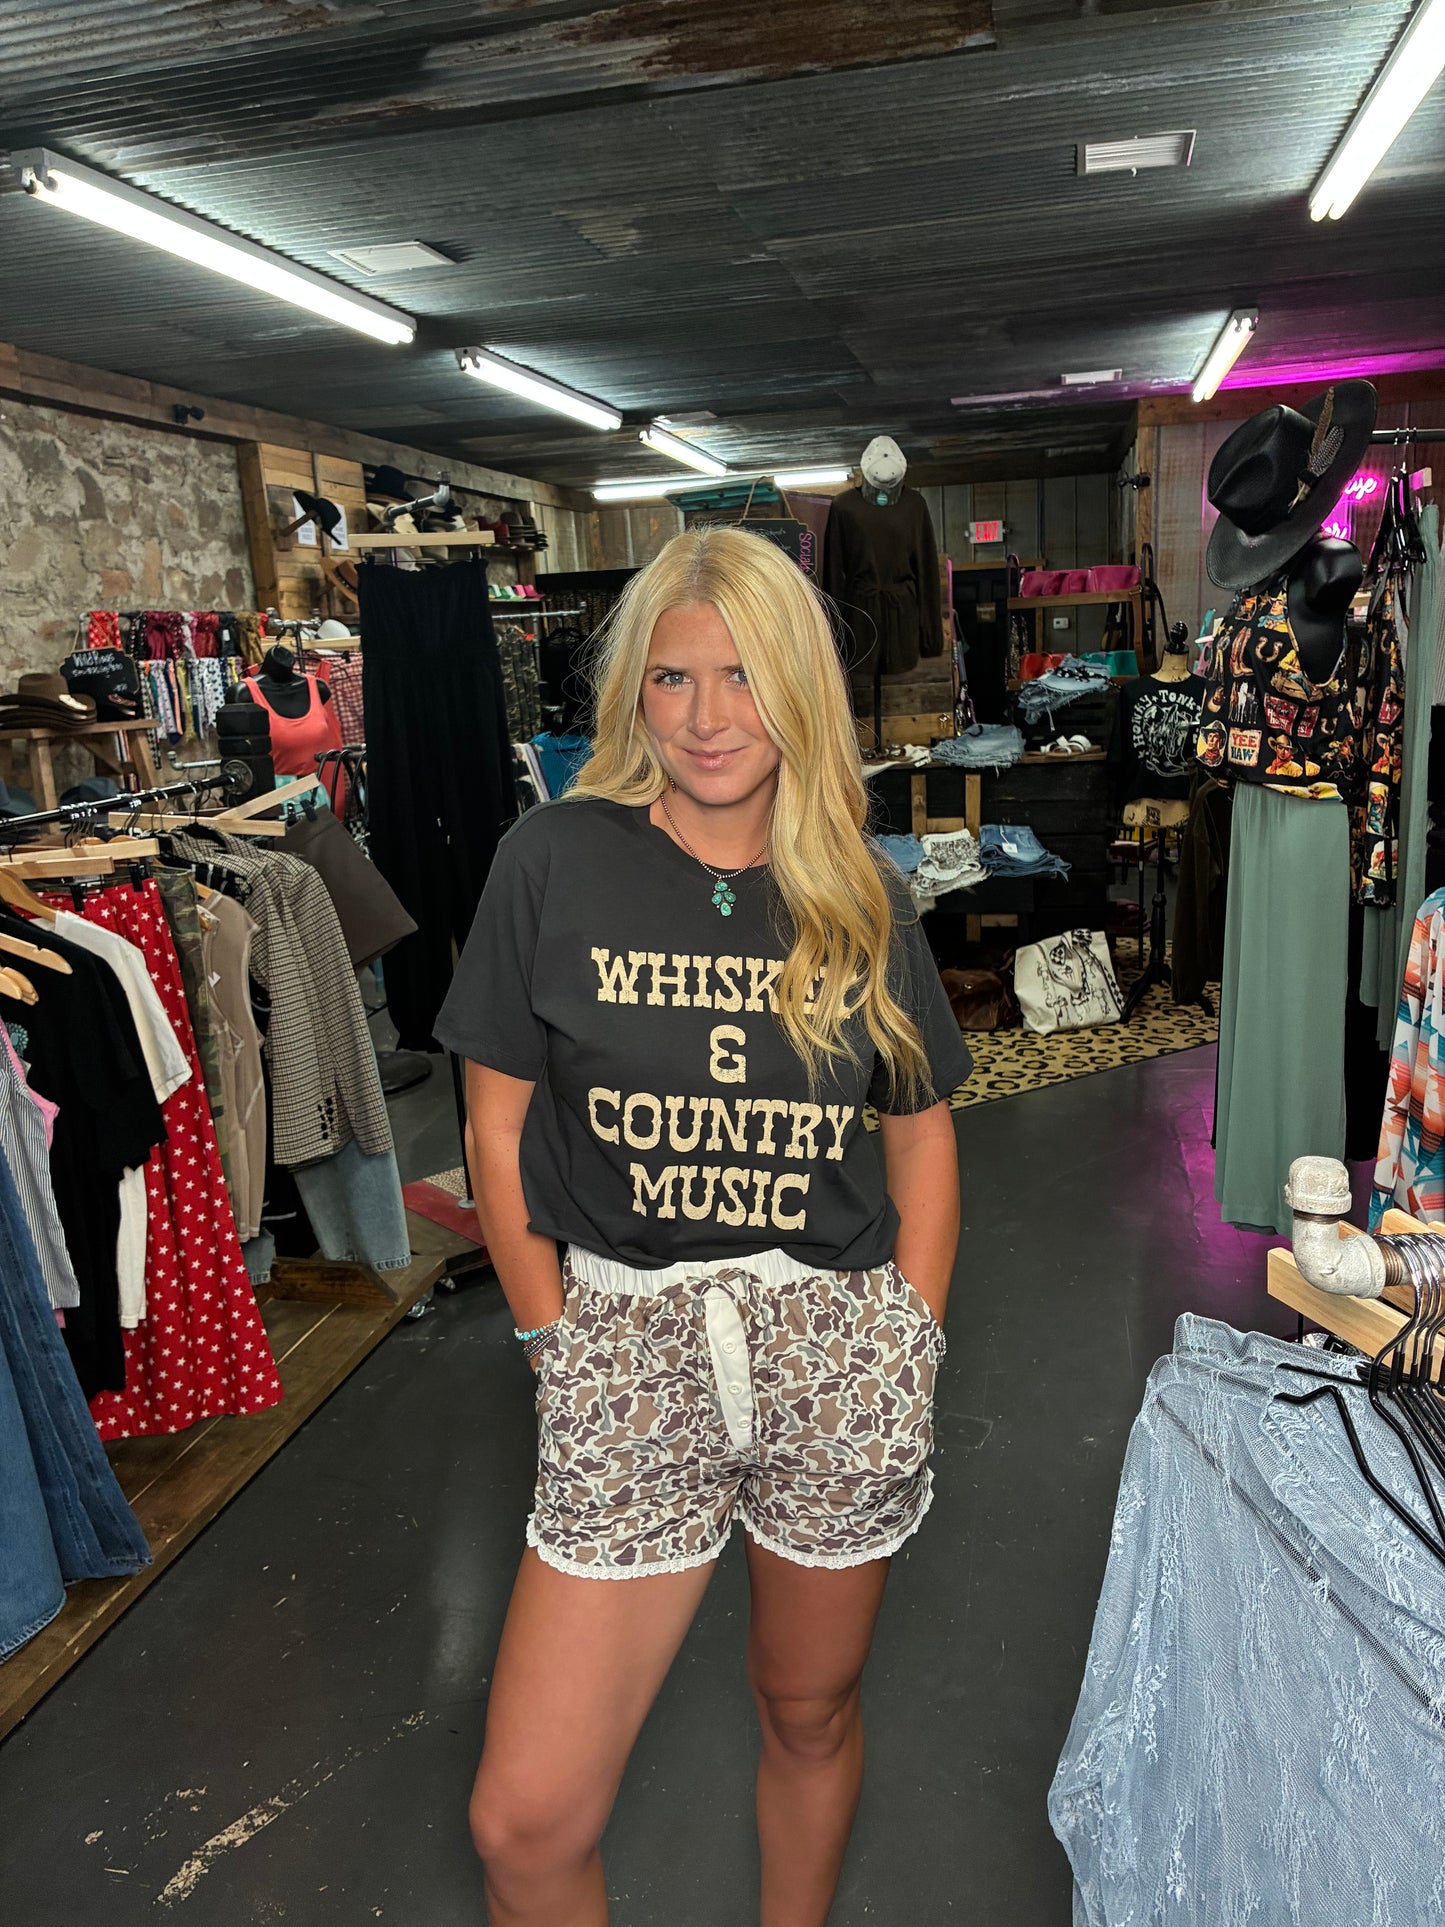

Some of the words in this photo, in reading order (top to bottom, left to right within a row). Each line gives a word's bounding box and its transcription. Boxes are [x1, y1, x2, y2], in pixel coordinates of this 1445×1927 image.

[975, 521, 999, 542] EXIT
[1230, 746, 1256, 761] HAW
[1231, 733, 1256, 748] YEE
[709, 1024, 747, 1083] &
[588, 1087, 855, 1161] COUNTRY
[629, 1162, 810, 1230] MUSIC
